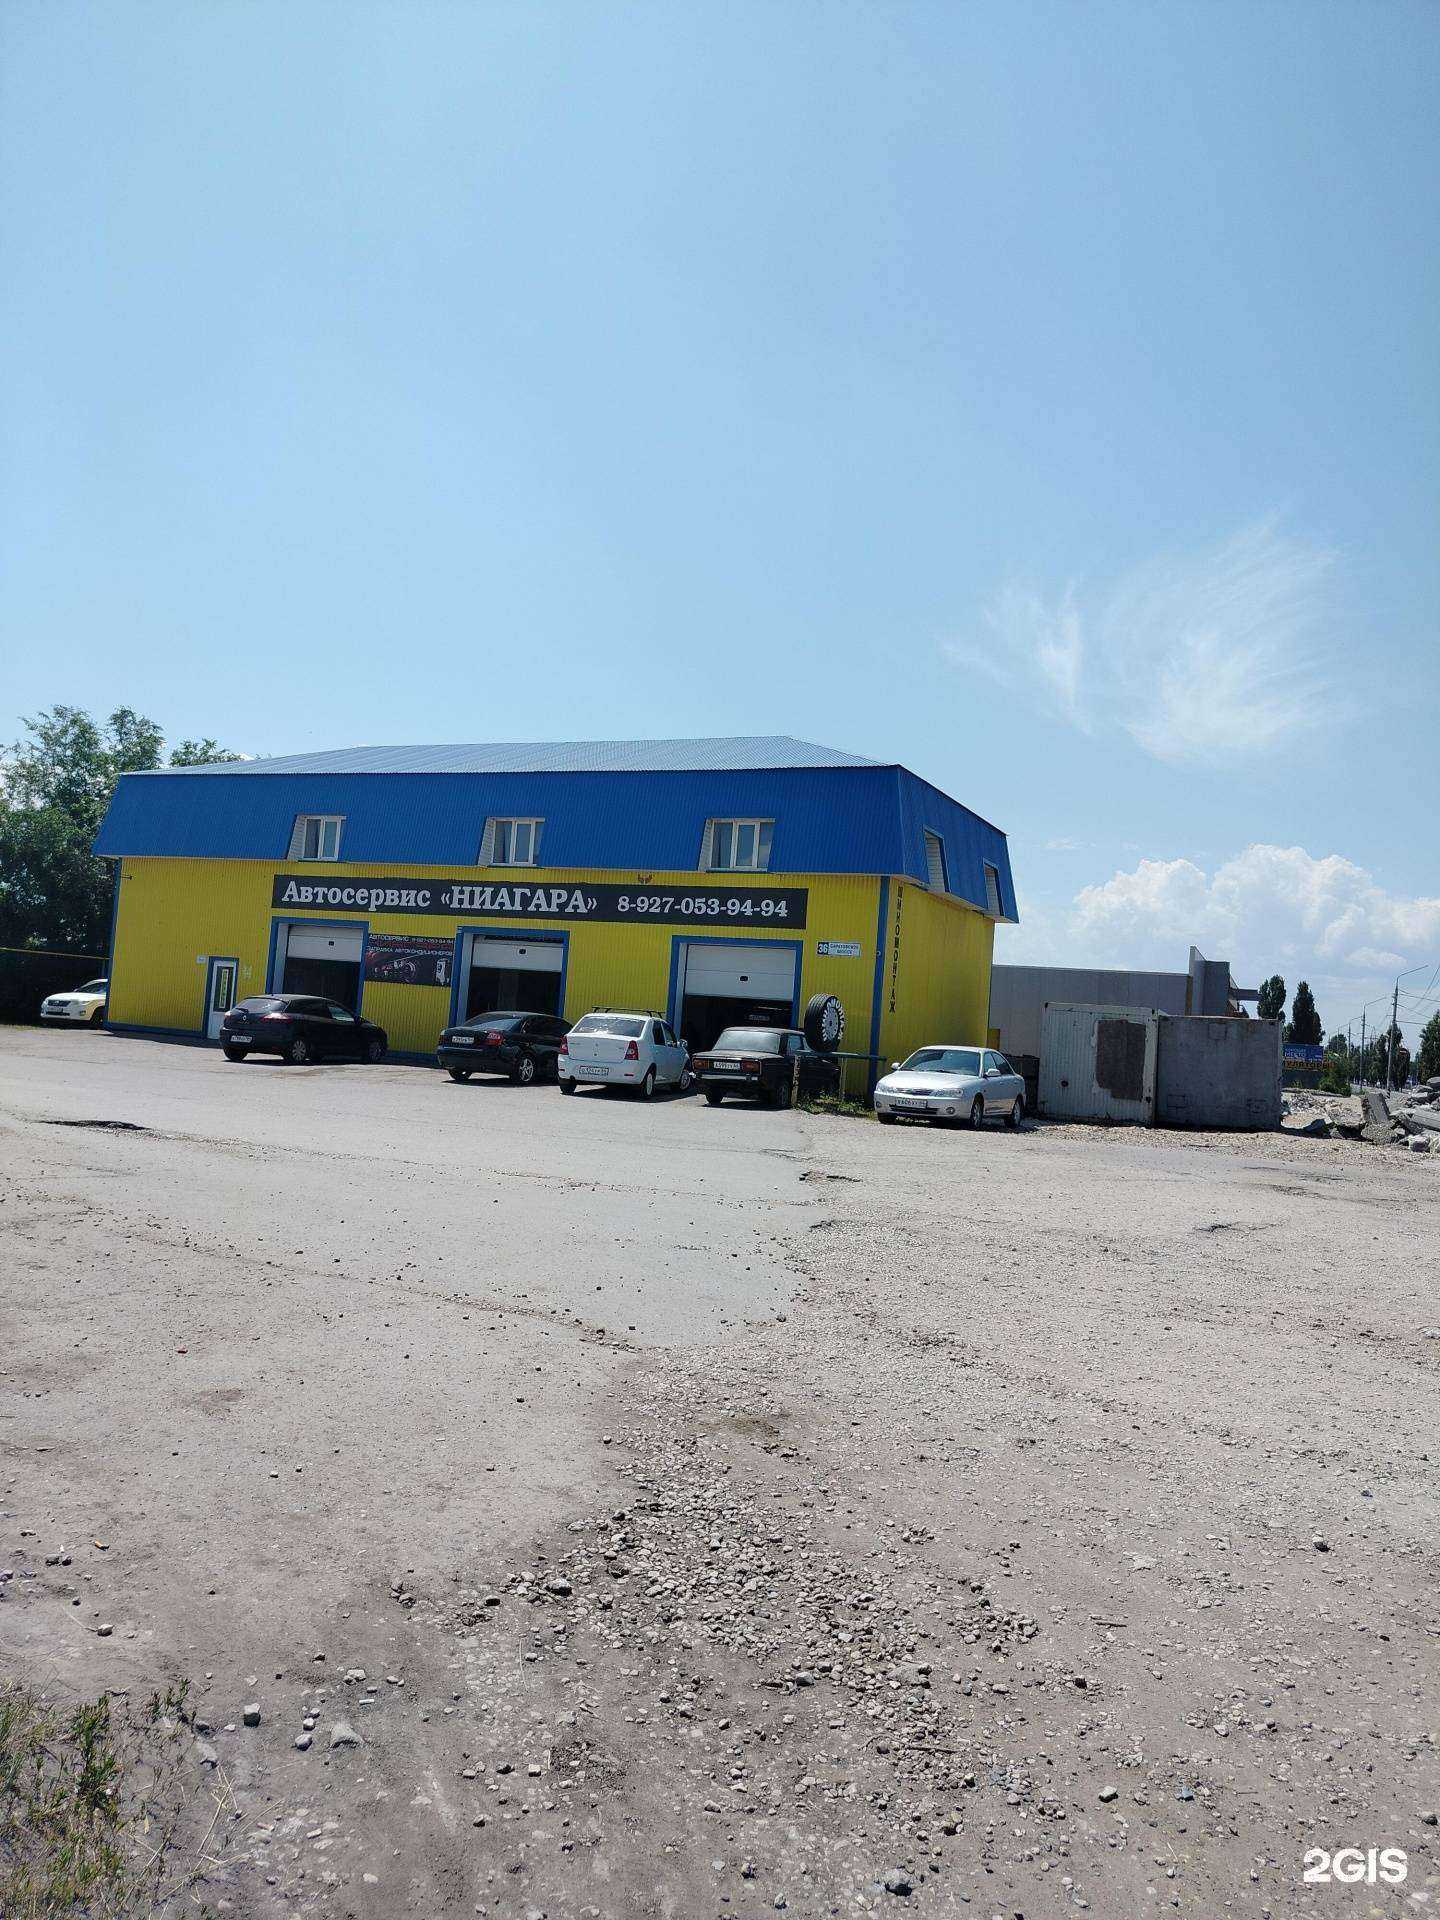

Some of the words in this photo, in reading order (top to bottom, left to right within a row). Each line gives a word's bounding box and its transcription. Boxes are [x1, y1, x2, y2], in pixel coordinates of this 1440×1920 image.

[282, 880, 431, 911] Автосервис
[440, 885, 598, 913] «НИАГАРА»
[617, 896, 788, 917] 8-927-053-94-94
[818, 943, 828, 954] 36
